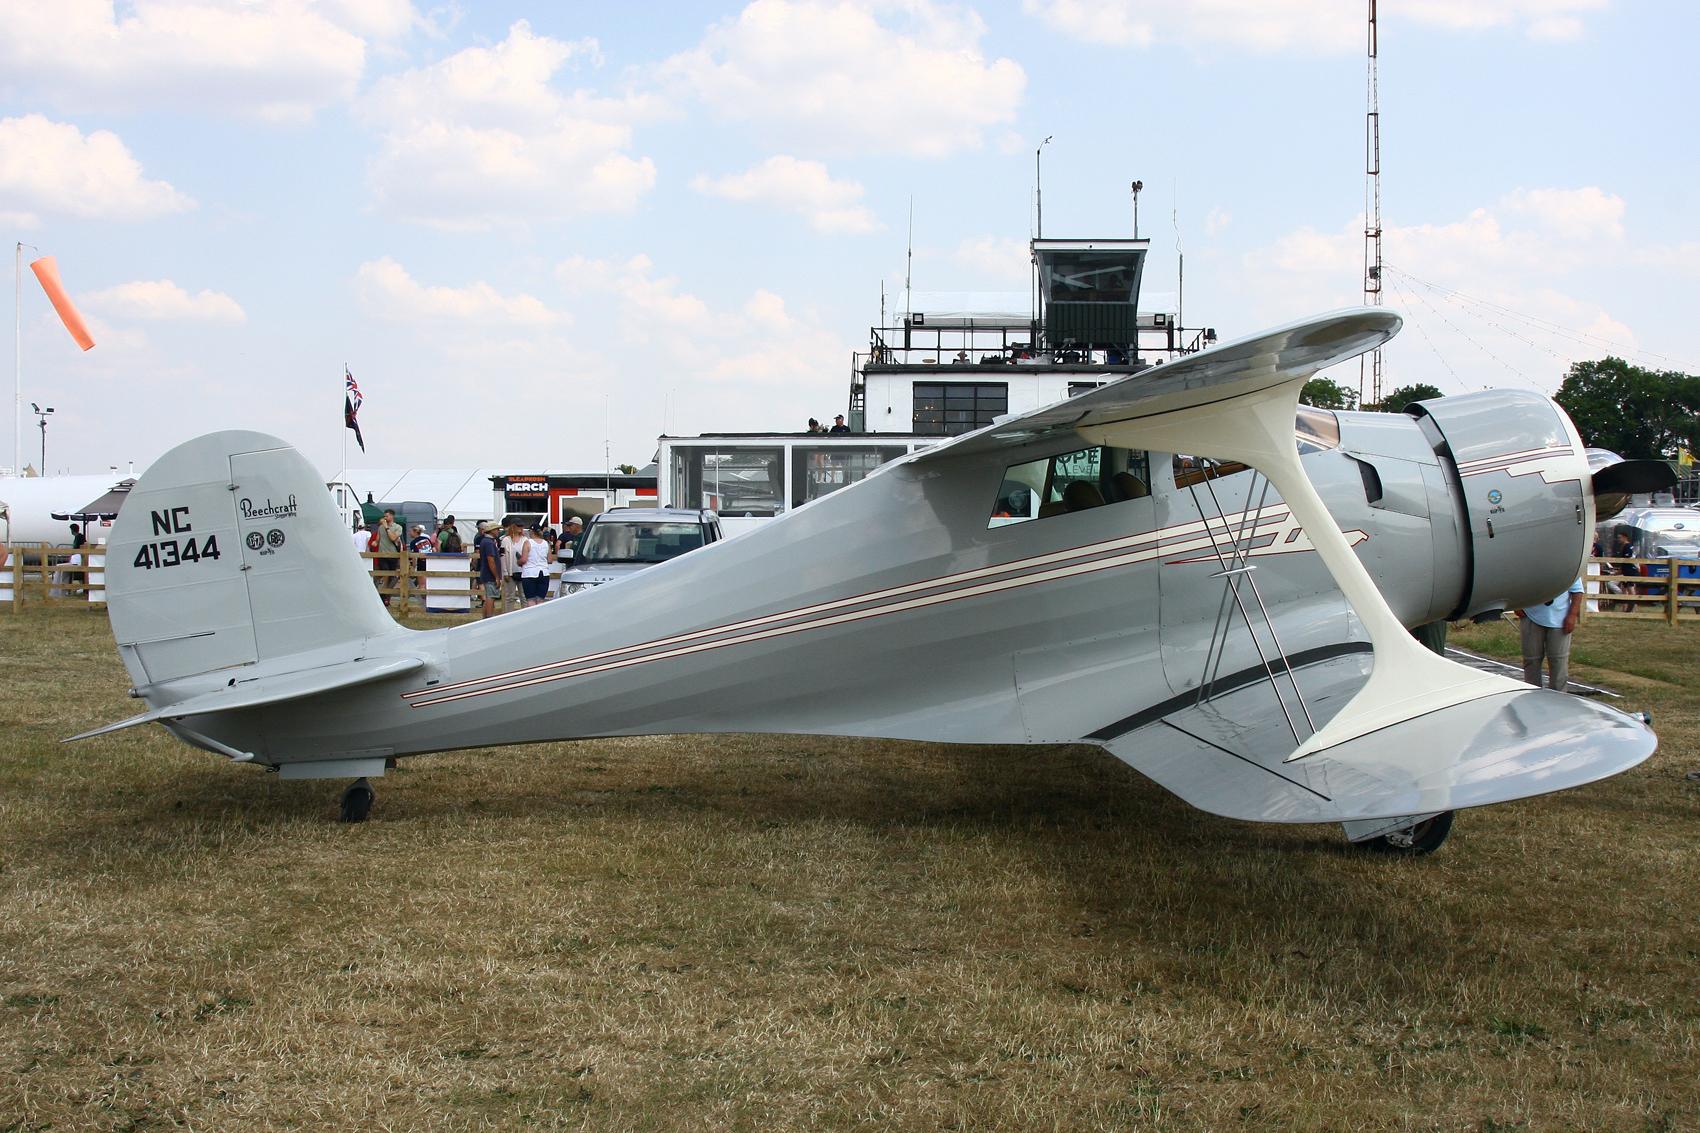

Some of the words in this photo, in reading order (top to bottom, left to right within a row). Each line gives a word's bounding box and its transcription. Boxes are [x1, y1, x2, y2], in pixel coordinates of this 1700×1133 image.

[506, 482, 548, 492] MERCH
[240, 494, 297, 518] Beechcraft
[151, 506, 192, 536] NC
[133, 534, 221, 570] 41344
